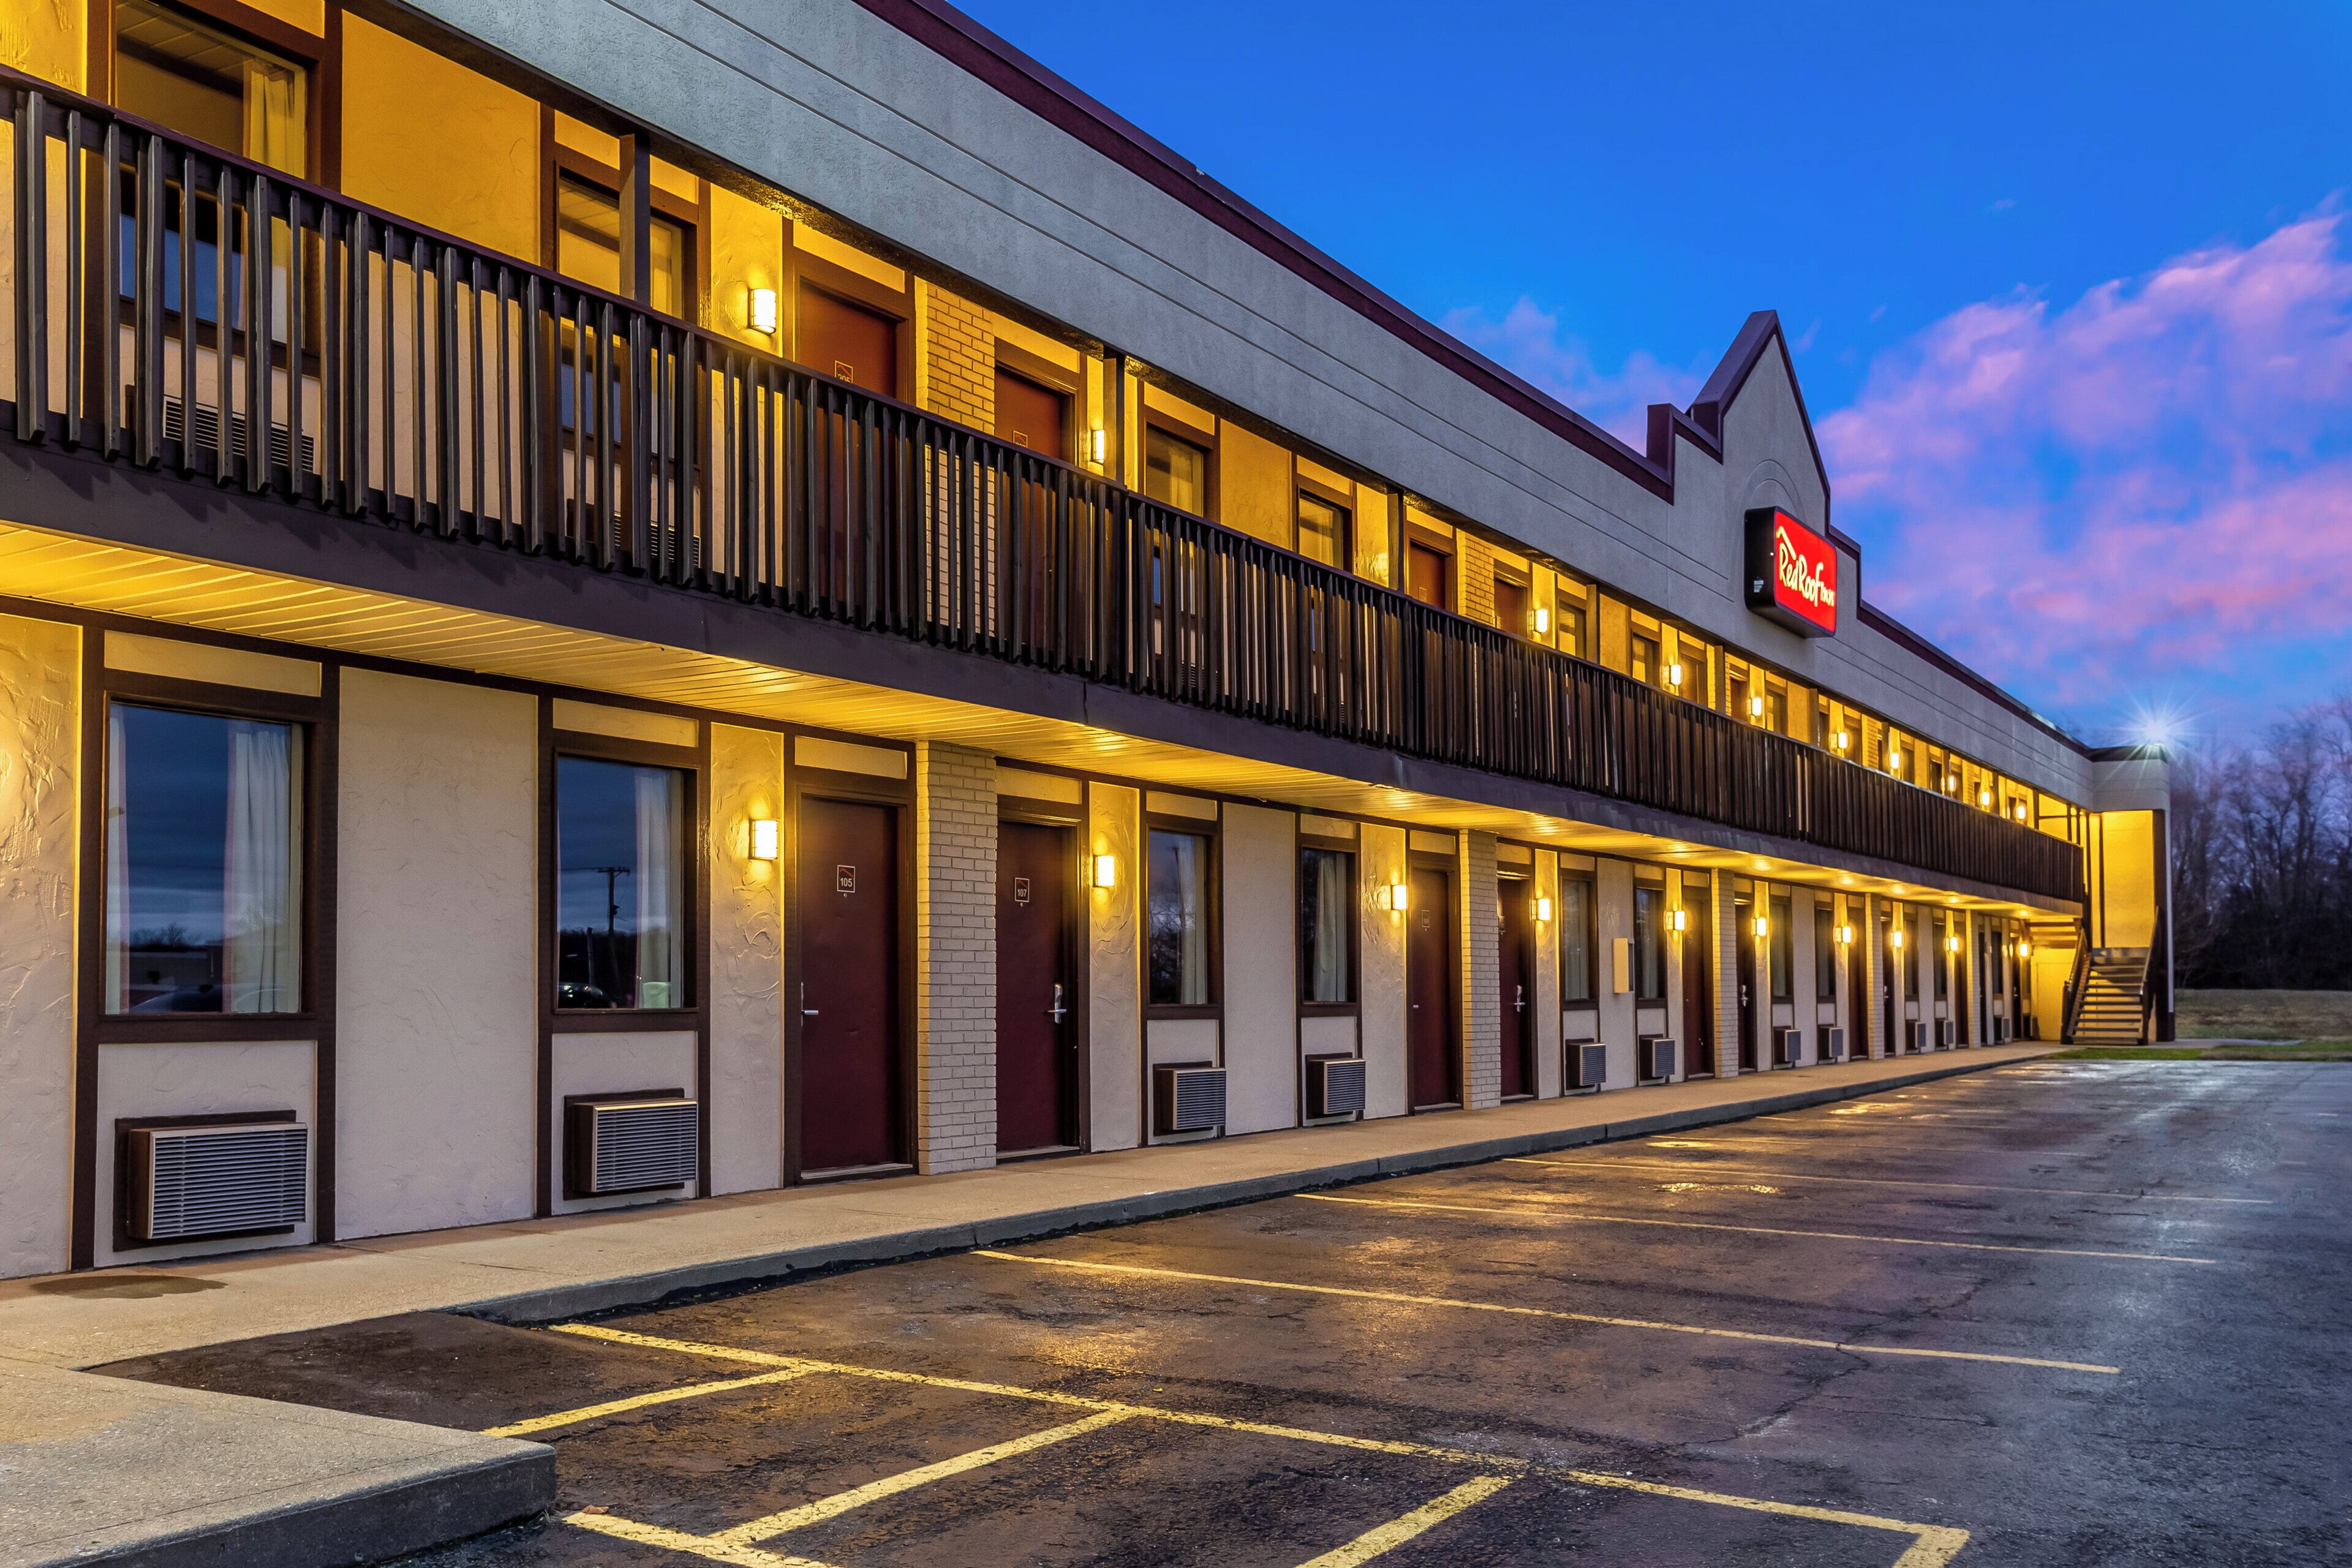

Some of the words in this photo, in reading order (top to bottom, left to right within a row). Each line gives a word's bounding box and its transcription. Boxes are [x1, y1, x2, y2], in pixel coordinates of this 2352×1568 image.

[1779, 542, 1799, 591] Red
[1798, 554, 1823, 607] Roof
[840, 877, 853, 888] 105
[1017, 888, 1027, 897] 107
